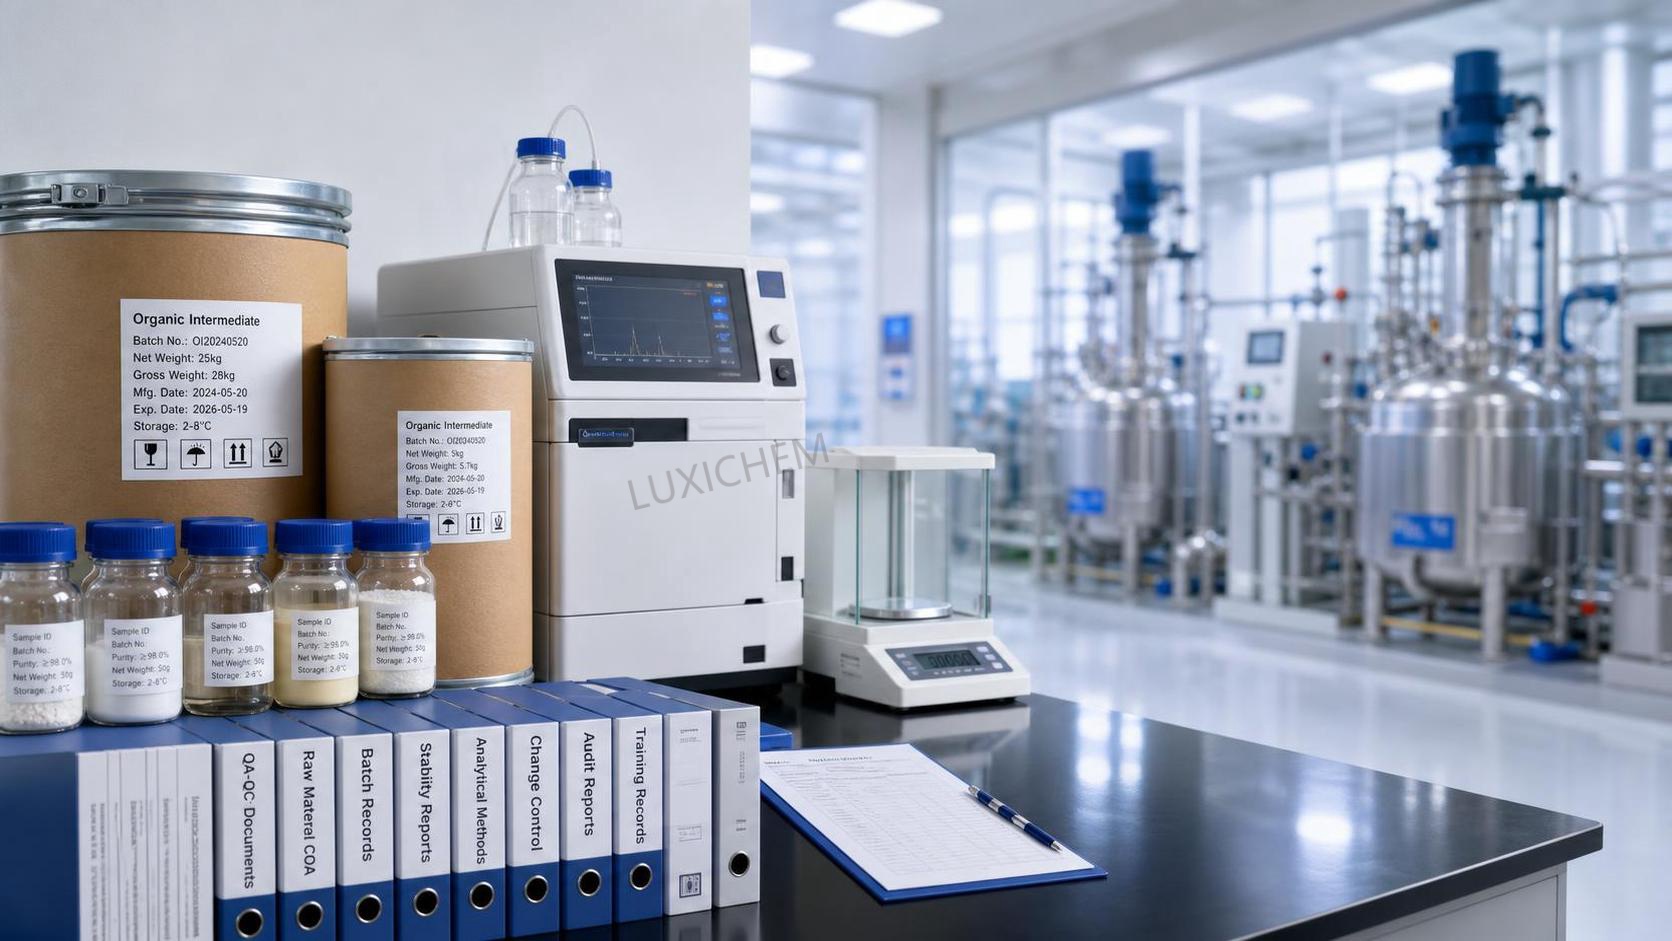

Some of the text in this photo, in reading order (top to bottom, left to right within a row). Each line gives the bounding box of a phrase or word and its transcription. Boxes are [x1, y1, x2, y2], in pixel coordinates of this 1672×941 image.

[133, 313, 260, 328] Organic Intermediate
[133, 336, 248, 346] Batch No.: OI20240520
[133, 353, 222, 365] Net Weight: 25kg
[133, 370, 235, 382] Gross Weight: 28kg
[133, 388, 248, 400] Mfg. Date: 2024-05-20
[134, 404, 248, 416] Exp. Date: 2026-05-19
[134, 421, 178, 433] Storage:
[406, 421, 493, 431] Organic Intermediate
[422, 451, 449, 459] Weight:
[452, 450, 464, 458] 5kg
[431, 463, 457, 471] Weight:
[460, 463, 478, 471] 5.7kg
[406, 476, 422, 484] Mfg.
[407, 488, 423, 496] Exp.
[407, 501, 438, 509] Storage:
[376, 611, 401, 620] Sample
[211, 622, 237, 630] Sample
[297, 618, 322, 627] Sample
[112, 627, 150, 636] Sample ID
[13, 633, 41, 642] Sample
[13, 647, 35, 655] Batch
[158, 664, 171, 672] 50g
[212, 660, 224, 668] Net
[303, 751, 315, 782] Raw
[582, 732, 596, 836] Audit Reports
[634, 727, 647, 845] Training Records
[528, 735, 543, 851] Change Control
[361, 749, 375, 862] Batch Records
[474, 737, 488, 865] Analytical Methods
[418, 804, 433, 863] Reports
[244, 808, 256, 890] Documents
[303, 845, 316, 876] COA
